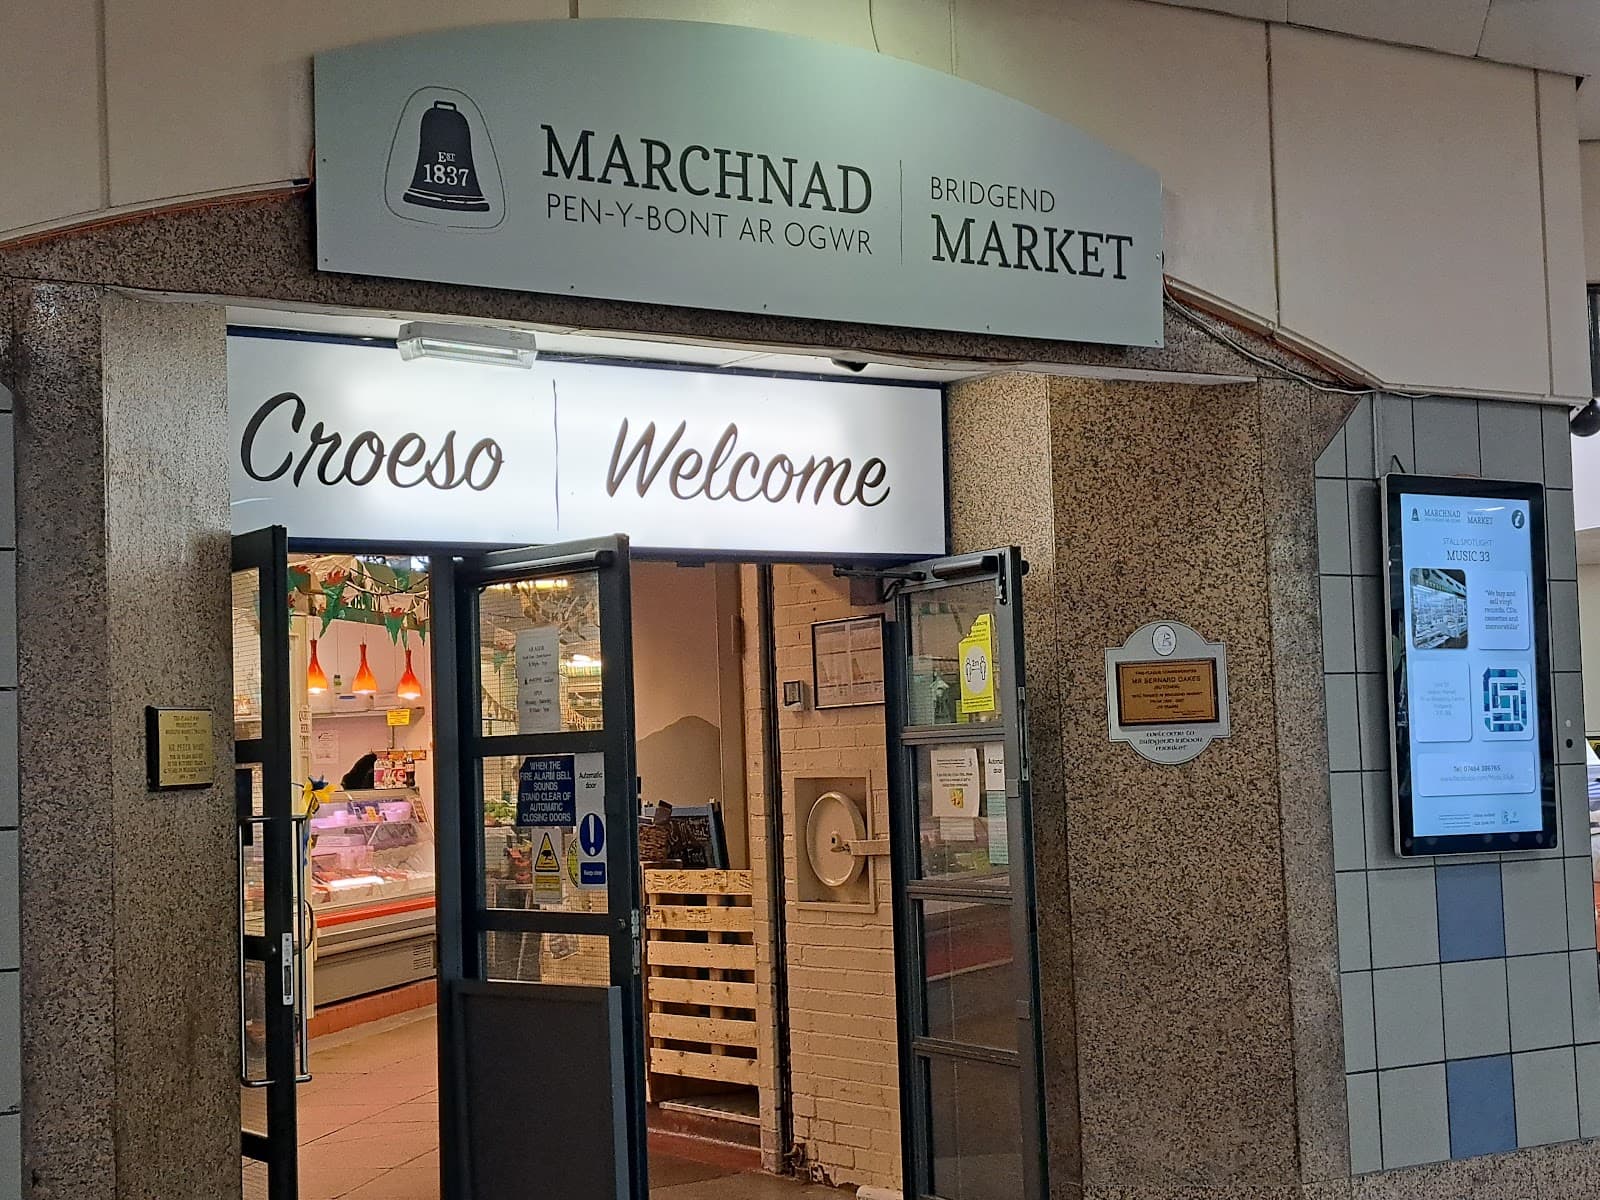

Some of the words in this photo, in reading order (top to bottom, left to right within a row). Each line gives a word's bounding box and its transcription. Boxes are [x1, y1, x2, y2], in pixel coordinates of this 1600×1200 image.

[540, 123, 873, 215] MARCHNAD
[423, 163, 469, 187] 1837
[931, 176, 1055, 213] BRIDGEND
[547, 193, 728, 239] PEN-Y-BONT
[739, 217, 774, 245] AR
[784, 222, 873, 255] OGWR
[931, 214, 1133, 280] MARKET
[240, 391, 505, 491] Croeso
[605, 417, 891, 508] Welcome
[1461, 539, 1493, 547] SPOTLIGHT
[1447, 550, 1478, 562] MUSIC
[1480, 551, 1491, 562] 33
[1144, 676, 1176, 684] BERNARD
[530, 760, 548, 770] WHEN
[550, 760, 561, 770] THE
[520, 771, 533, 781] FIRE
[533, 771, 556, 781] ALARM
[556, 770, 572, 780] BELL
[578, 771, 603, 781] Automatic
[533, 781, 558, 791] SOUNDS
[585, 781, 597, 789] door
[521, 792, 540, 802] STAND
[541, 791, 562, 801] CLEAR
[563, 791, 572, 801] OF
[529, 802, 564, 812] AUTOMATIC
[522, 813, 548, 822] CLOSING
[549, 812, 571, 822] DOORS
